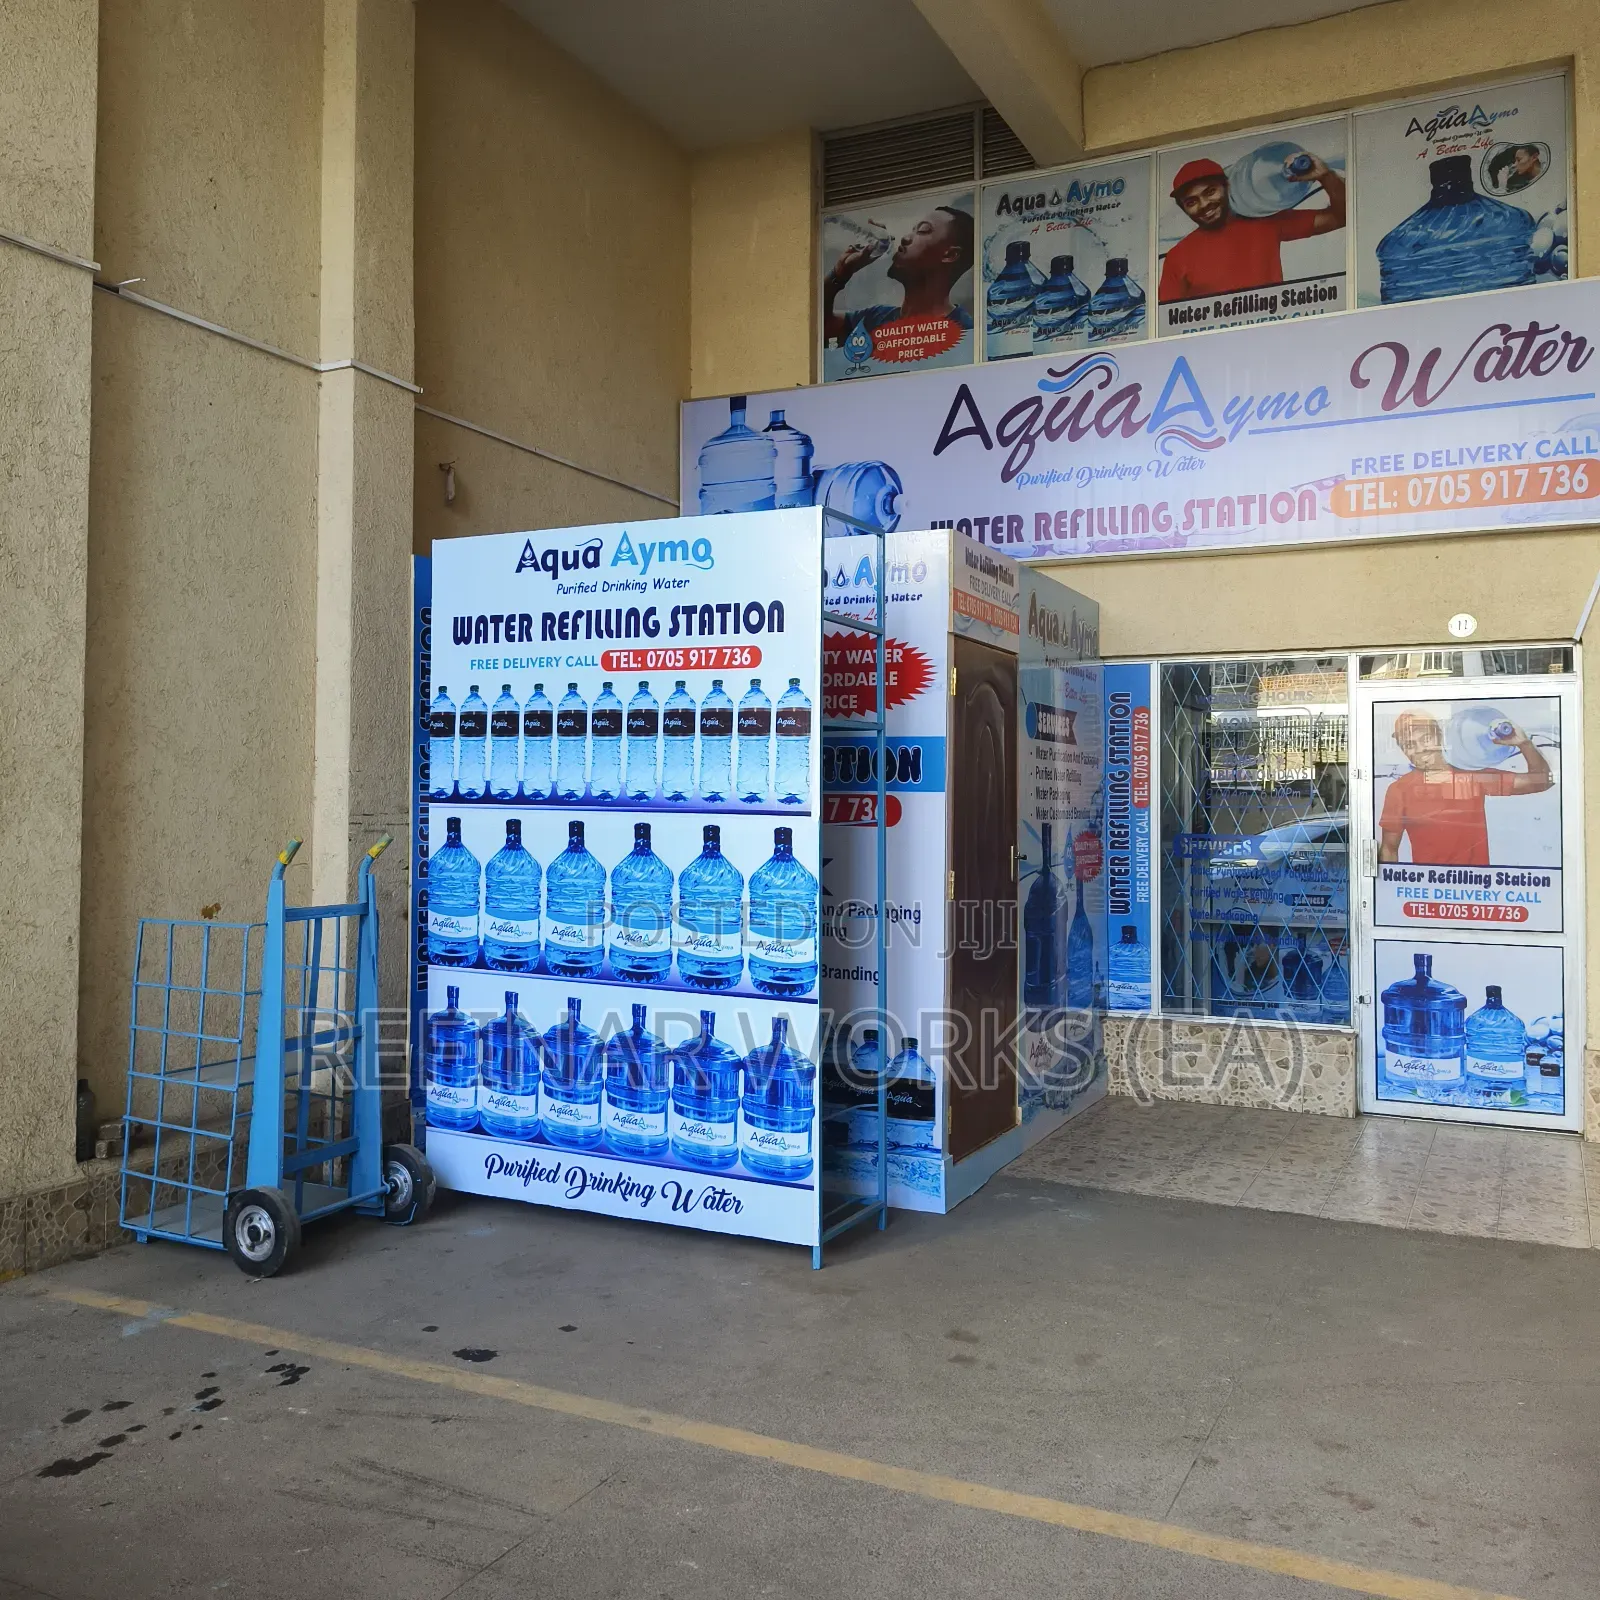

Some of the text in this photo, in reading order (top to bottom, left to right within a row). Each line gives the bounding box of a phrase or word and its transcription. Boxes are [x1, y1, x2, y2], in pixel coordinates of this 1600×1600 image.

[1416, 137, 1494, 160] A Better Life
[996, 178, 1126, 216] Aqua Aymo
[1030, 225, 1040, 235] A
[1046, 222, 1072, 232] Better
[1168, 305, 1210, 326] Water
[1213, 293, 1278, 318] Refilling
[1281, 284, 1338, 307] Station
[875, 320, 949, 338] QUALITY WATER
[876, 333, 947, 351] @AFFORDABLE
[898, 348, 924, 359] PRICE
[1349, 320, 1596, 412] Water
[1351, 436, 1599, 475] FREE DELIVERY CALL
[1016, 455, 1207, 490] Purified Drinking Water
[1344, 463, 1589, 512] TEL: 0705 917 736
[1034, 501, 1172, 542] REFILLING
[1182, 489, 1317, 531] STATION
[514, 530, 714, 580] Aqua Aymo
[556, 577, 690, 595] Purified Drinking Water
[892, 594, 922, 602] Water
[452, 600, 785, 646] WATER REFILLING STATION
[1028, 589, 1060, 650] Aqua
[470, 655, 598, 671] FREE DELIVERY CALL
[609, 648, 751, 669] TEL: 0705 917 736
[1267, 691, 1315, 702] HOURS
[1134, 712, 1149, 803] TEL: 0705 917 736
[1035, 766, 1053, 781] Purified
[1108, 692, 1132, 916] WATER REFILLING STATION
[1136, 811, 1149, 903] FREE DELIVERY CALL
[1179, 837, 1252, 855] SERVICES
[1382, 868, 1551, 888] Water Refilling Station
[1396, 887, 1541, 903] FREE DELIVERY CALL
[1410, 903, 1521, 920] TEL: 0705 917 736
[887, 1091, 913, 1105] Aqua
[484, 1153, 744, 1215] Purified Drinking Water
